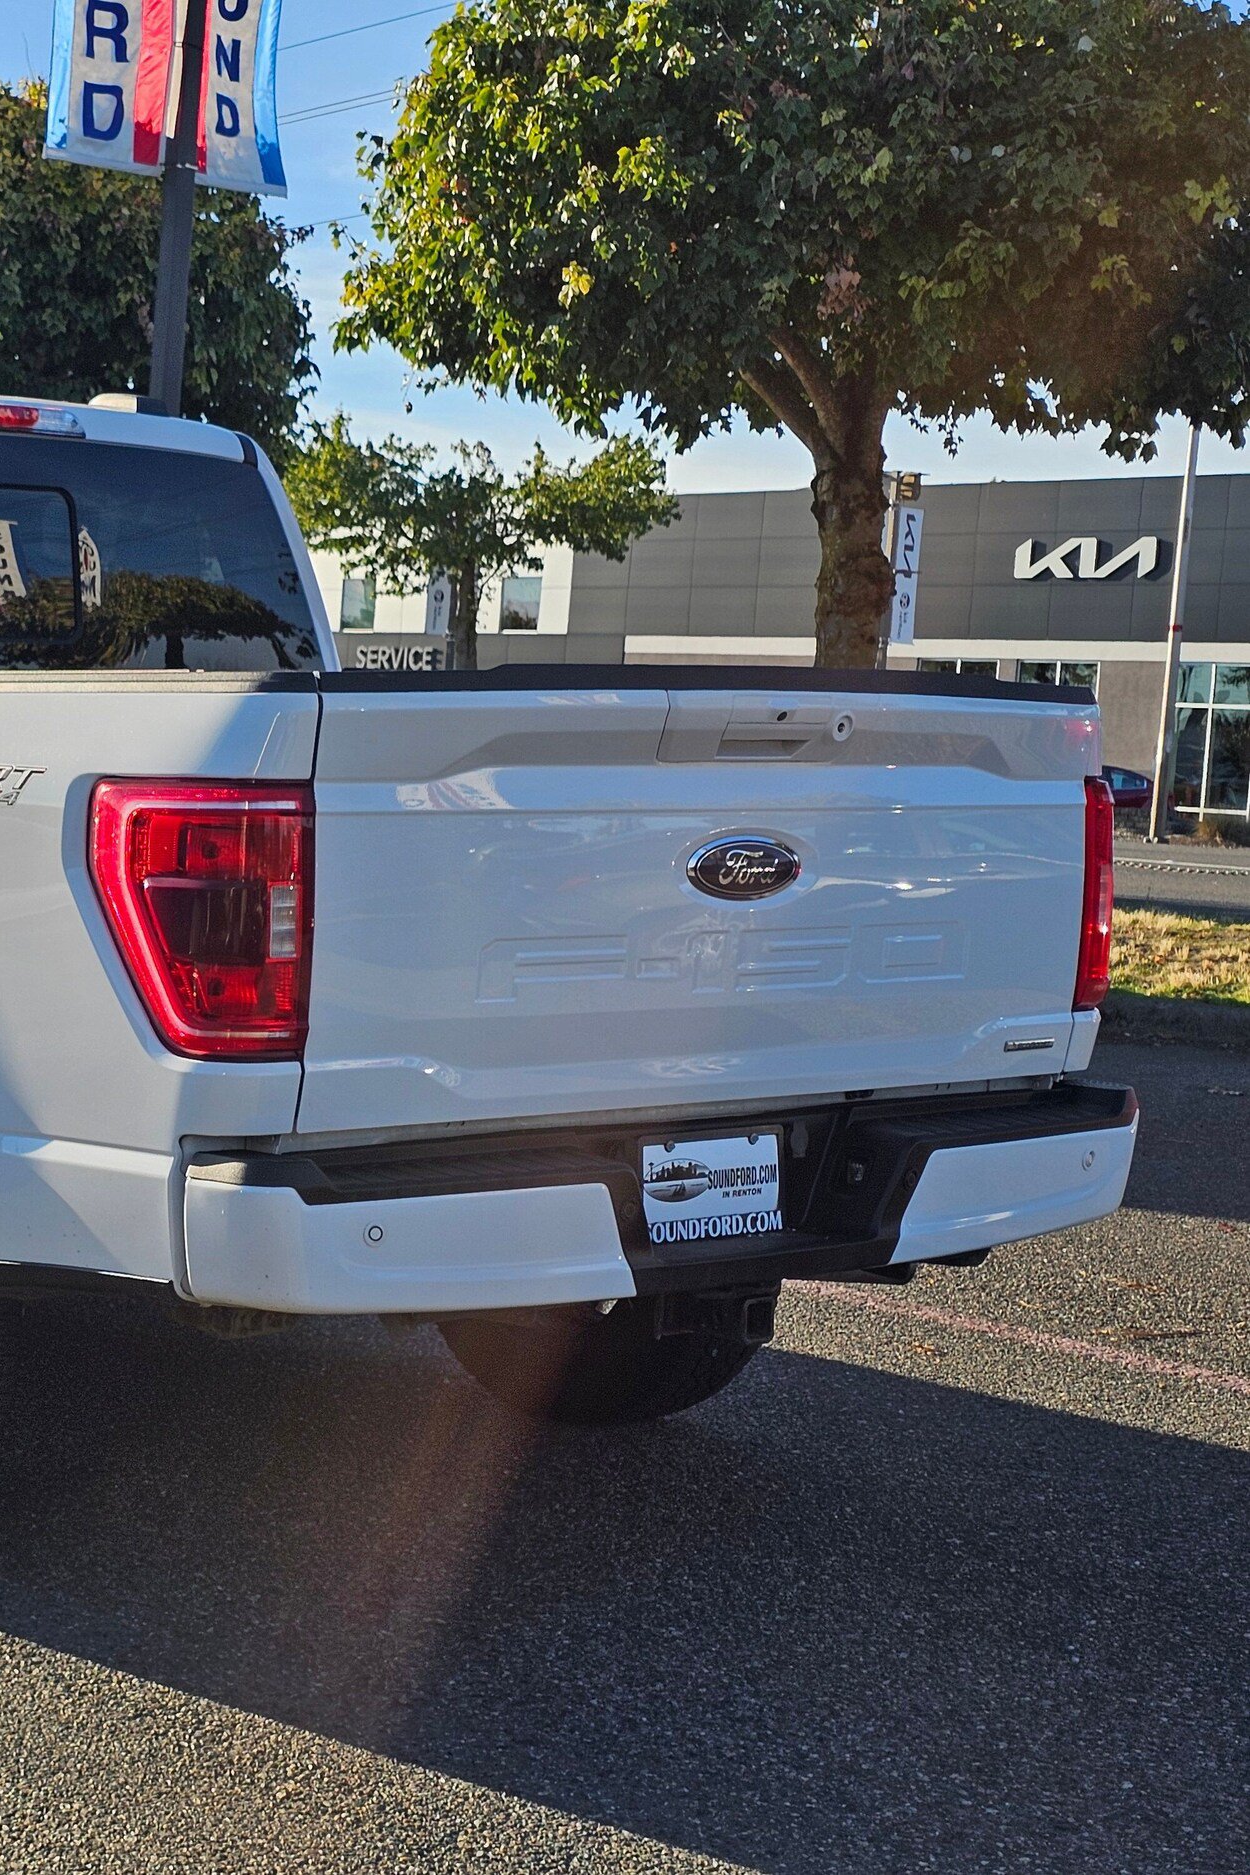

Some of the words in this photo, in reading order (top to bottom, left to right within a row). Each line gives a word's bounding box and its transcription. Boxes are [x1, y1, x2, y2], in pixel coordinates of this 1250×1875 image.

[1014, 536, 1157, 579] KIA
[355, 645, 432, 671] SERVICE
[718, 849, 777, 885] Ford
[707, 1164, 777, 1190] SOUNDFORD.COM
[722, 1190, 730, 1199] IN
[733, 1187, 762, 1197] RENTON
